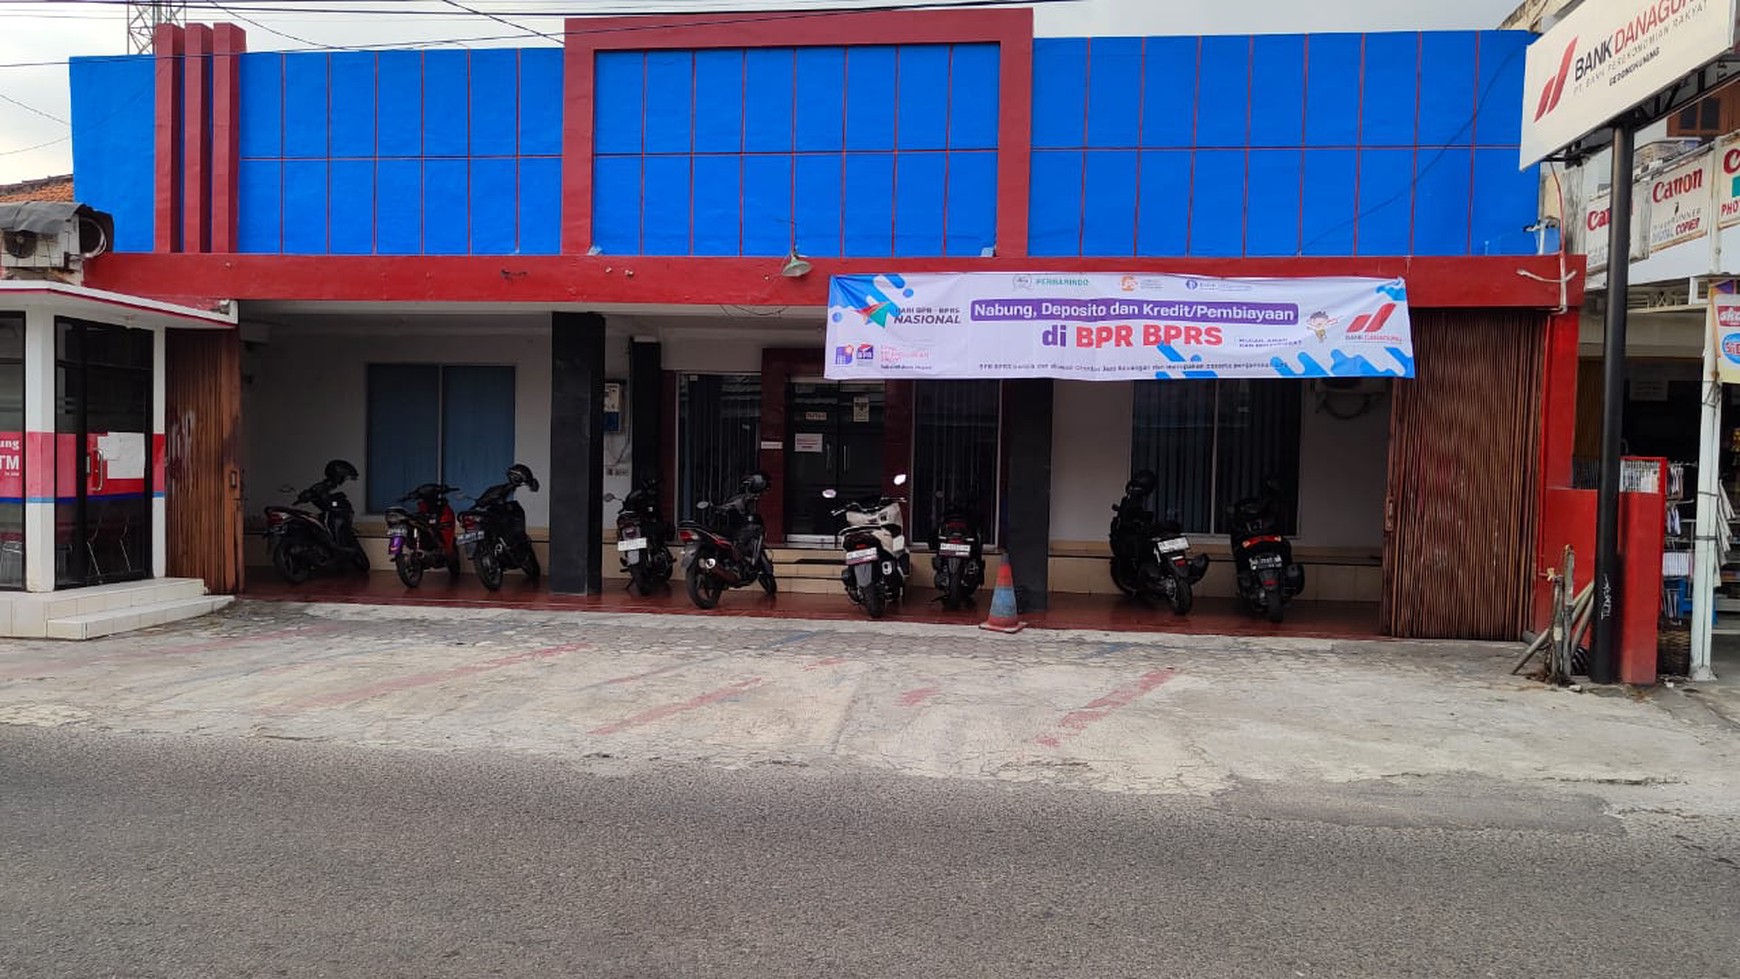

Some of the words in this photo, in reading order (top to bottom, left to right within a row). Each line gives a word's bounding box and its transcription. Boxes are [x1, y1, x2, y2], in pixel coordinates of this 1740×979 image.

[1574, 35, 1613, 82] BANK
[1652, 168, 1703, 203] Canon
[1721, 200, 1740, 217] PHO
[894, 315, 961, 324] NASIONAL
[974, 303, 1037, 318] Nabung,
[1041, 302, 1106, 318] Deposito
[1110, 302, 1138, 316] dan
[1142, 302, 1295, 322] Kredit/Pembiayaan
[1042, 325, 1067, 347] di
[1076, 325, 1134, 348] BPR
[1142, 324, 1223, 347] BPRS
